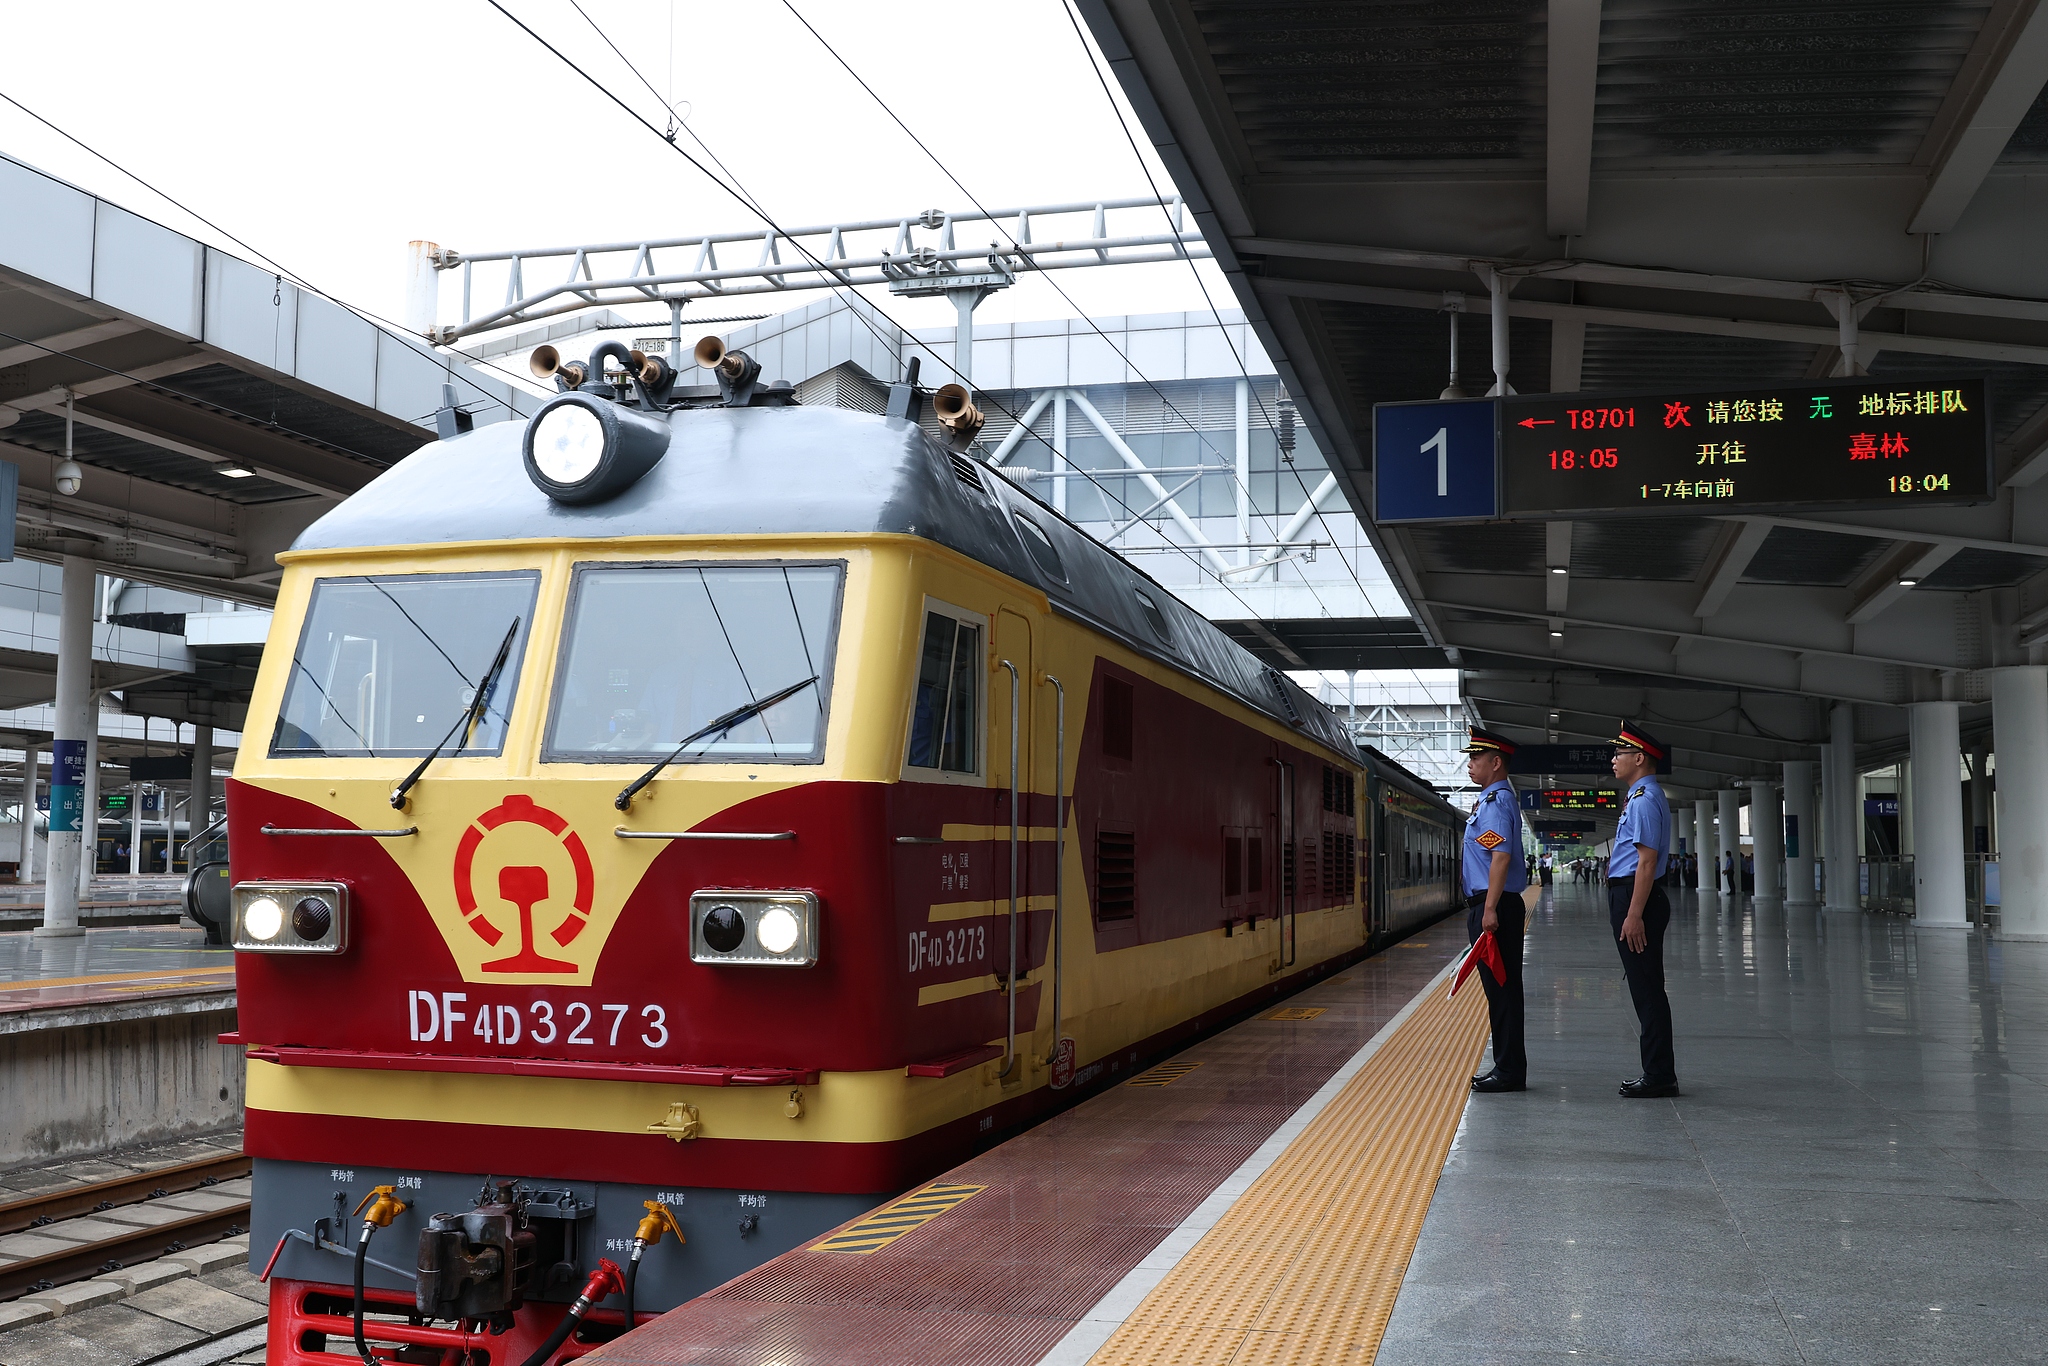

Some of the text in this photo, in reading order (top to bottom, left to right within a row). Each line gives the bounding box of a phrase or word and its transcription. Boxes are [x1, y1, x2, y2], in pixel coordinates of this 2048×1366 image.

[1566, 389, 1968, 430] T8701 次 请您按 无 地标排队
[1548, 431, 1910, 470] 18:05 开往 嘉林
[1420, 427, 1447, 496] 1
[1640, 473, 1951, 499] 1-7车向前 18:04
[1568, 749, 1608, 761] 南宁站
[42, 797, 48, 808] 9
[147, 798, 153, 808] 8
[1527, 794, 1534, 806] 1
[1877, 802, 1883, 814] 1
[330, 1169, 355, 1182] 平均管
[397, 1176, 422, 1190] 总风管
[656, 1192, 685, 1206] 总风管
[738, 1194, 767, 1208] 平均管
[606, 1238, 634, 1252] 列车管
